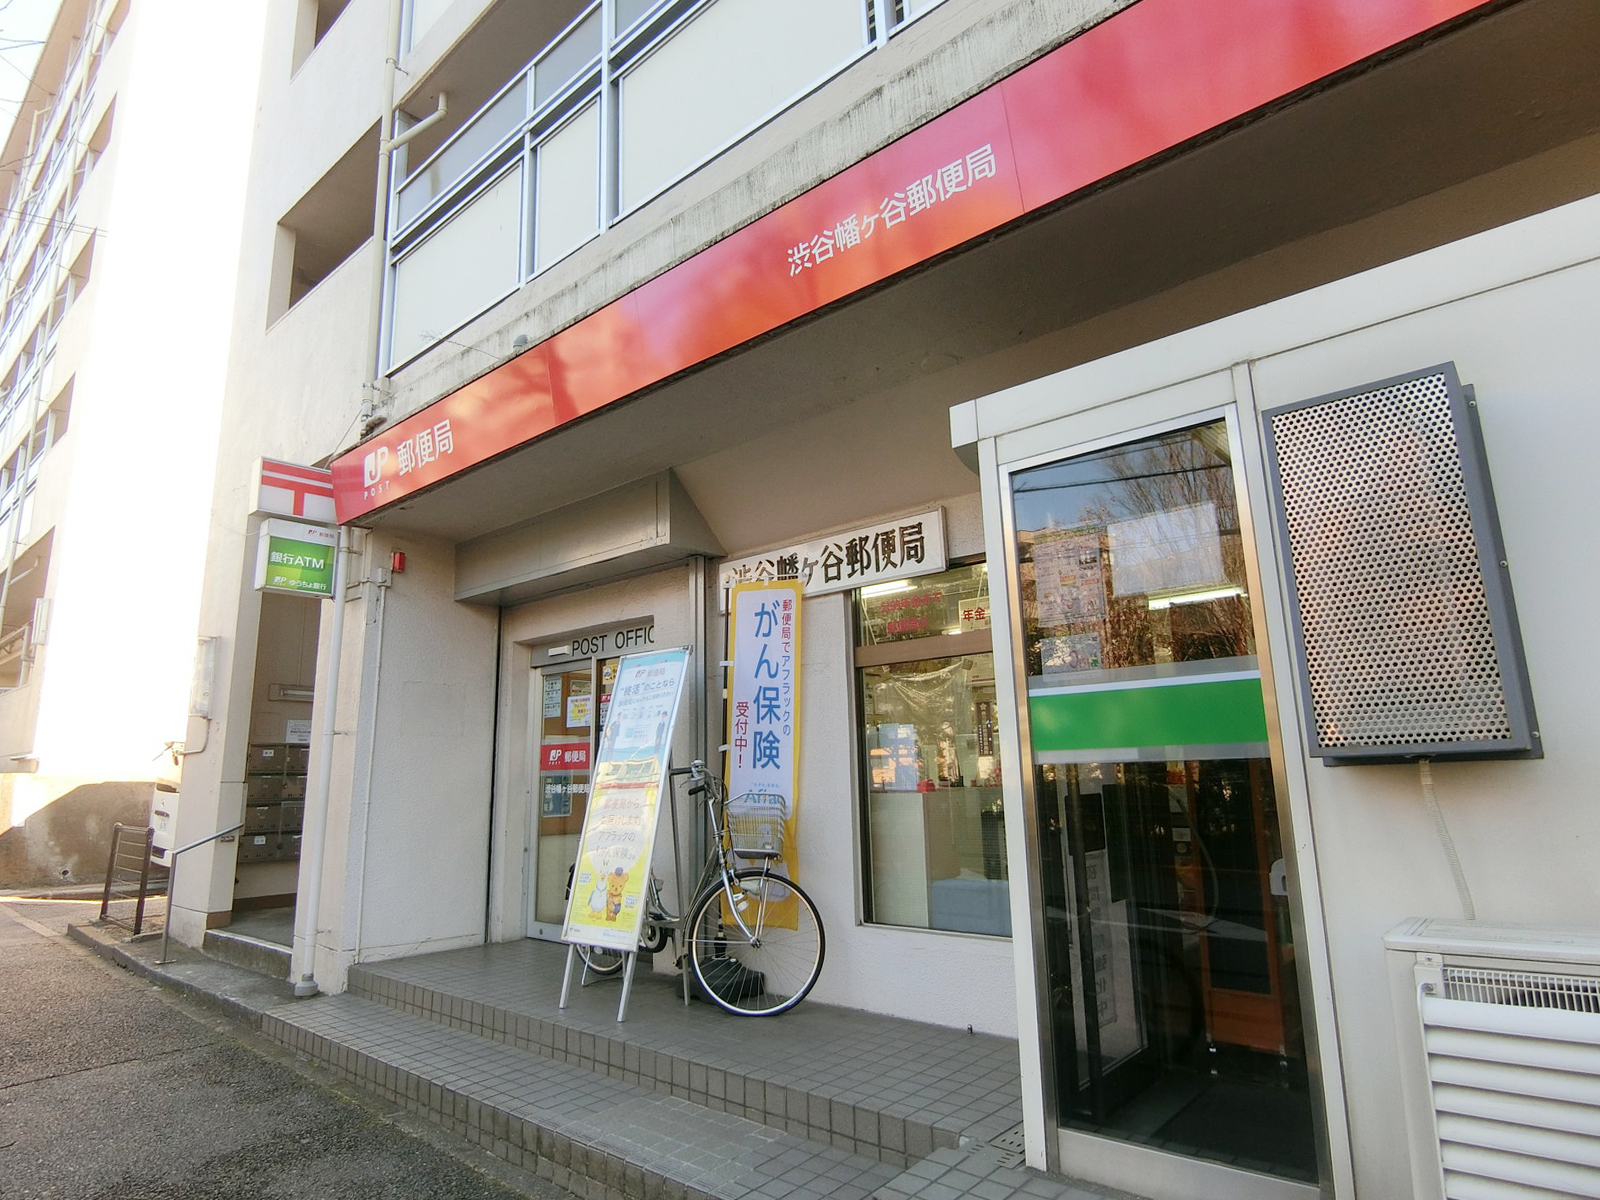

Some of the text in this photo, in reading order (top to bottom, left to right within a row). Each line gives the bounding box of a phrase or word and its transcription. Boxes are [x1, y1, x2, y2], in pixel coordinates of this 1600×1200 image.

[787, 143, 997, 277] 渋谷幡ヶ谷郵便局
[397, 418, 454, 476] 郵便局
[363, 480, 390, 500] POST
[270, 551, 325, 569] 銀行ATM
[289, 579, 327, 590] ゆうちょ銀行
[963, 607, 985, 621] 年金
[572, 634, 607, 657] POST
[781, 599, 793, 736] 郵便局でアフラックの
[753, 600, 781, 770] がん保険
[735, 701, 749, 769] 受付中！
[564, 750, 586, 763] 郵便局
[598, 831, 636, 842] アフラックの
